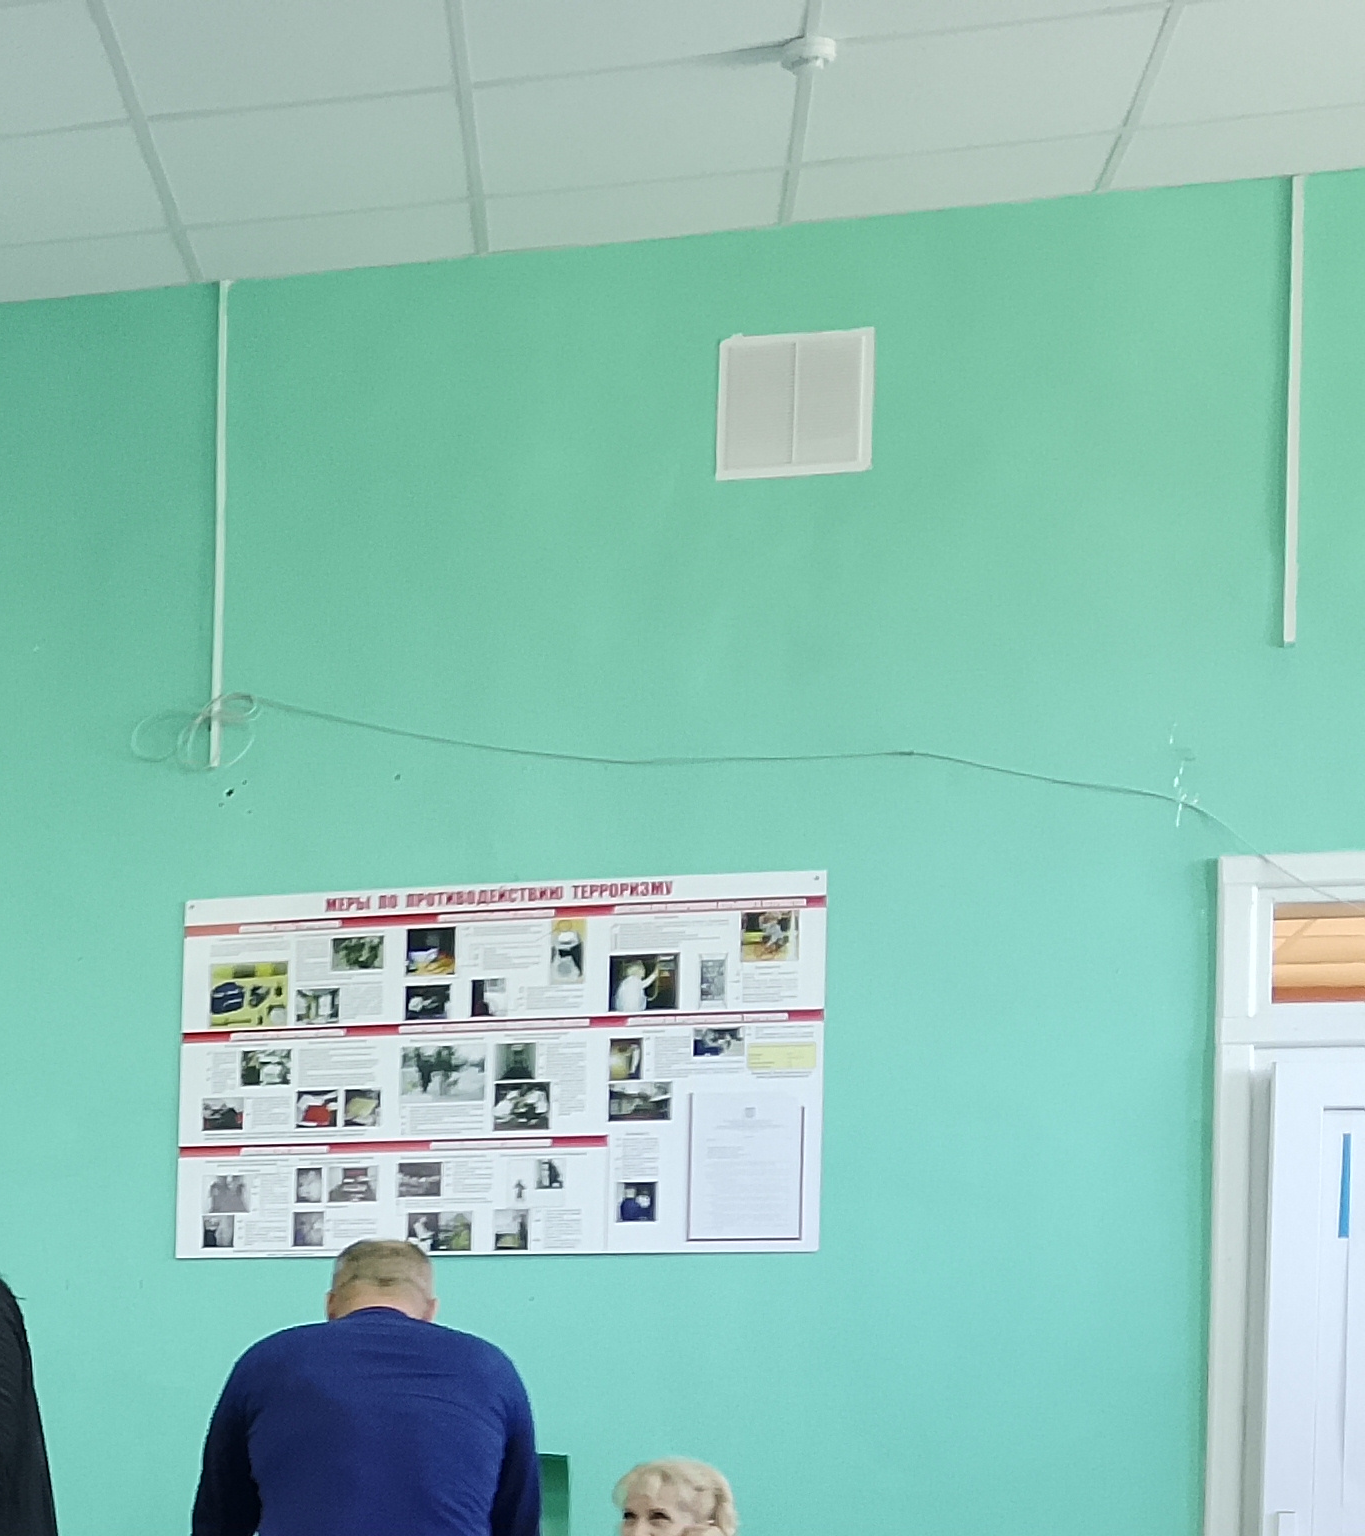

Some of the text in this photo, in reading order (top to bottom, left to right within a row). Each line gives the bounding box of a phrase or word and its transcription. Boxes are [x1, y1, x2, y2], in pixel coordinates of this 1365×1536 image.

[325, 880, 673, 912] МЕРЫ ПО ПРОТИВОДЕЙСТВИЮ ТЕРРОРИЗМУ
